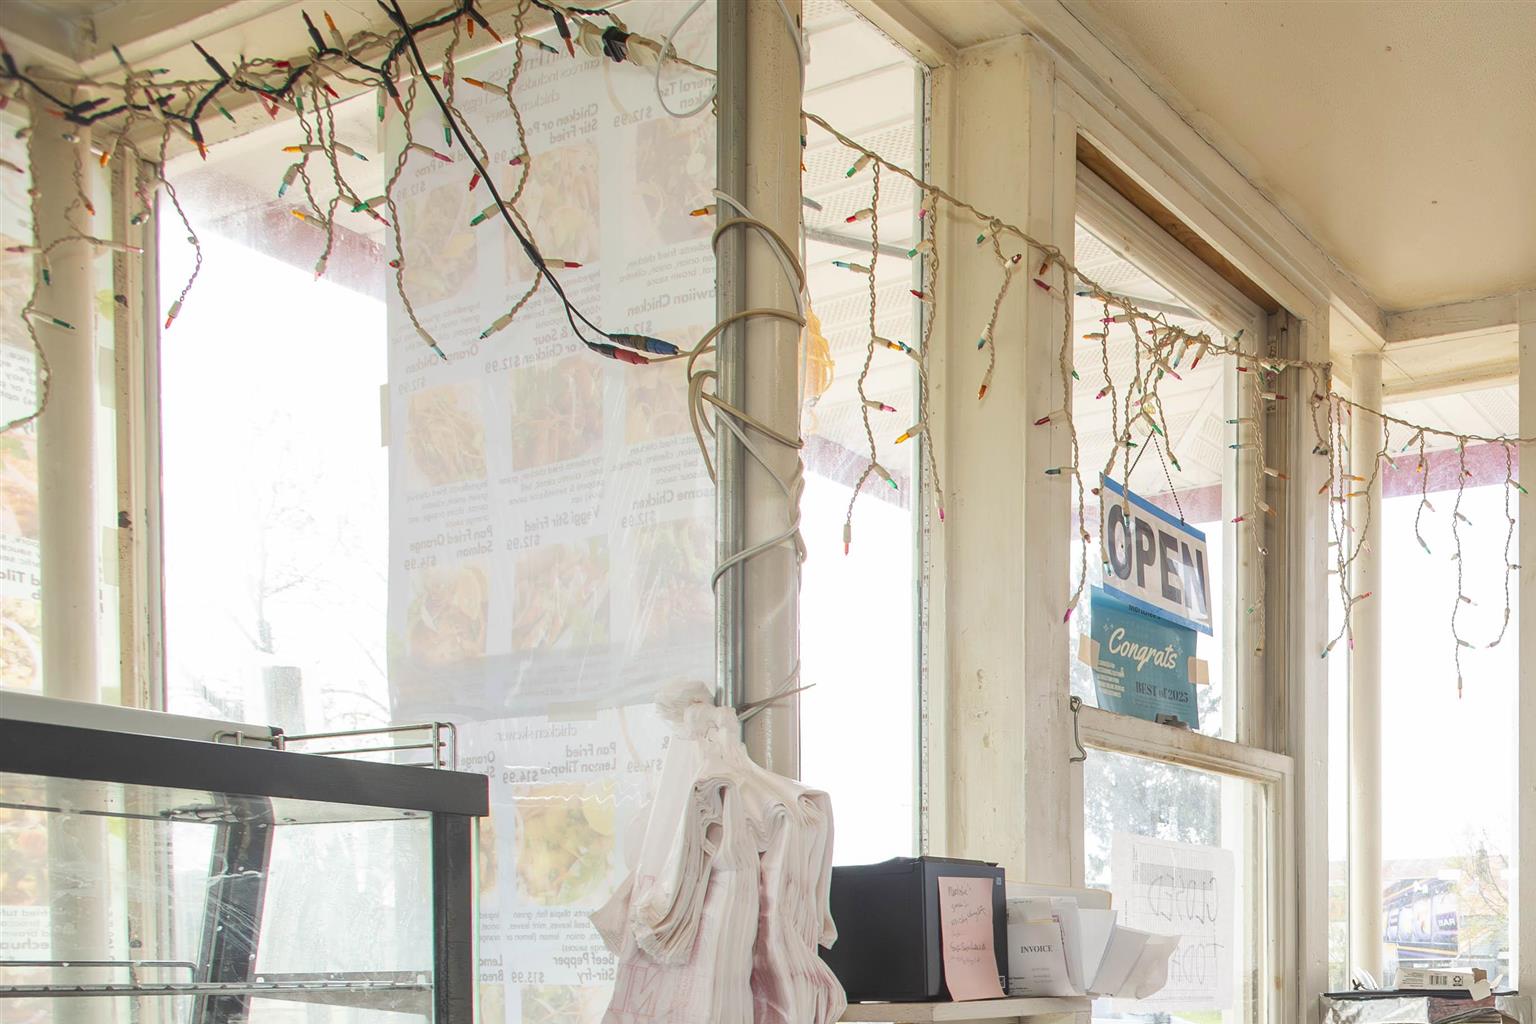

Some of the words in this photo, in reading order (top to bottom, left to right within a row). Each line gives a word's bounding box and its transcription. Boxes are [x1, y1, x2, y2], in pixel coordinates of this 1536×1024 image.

[1108, 504, 1208, 614] OPEN
[1109, 627, 1178, 672] Congrats
[1136, 681, 1156, 697] BEST
[1167, 688, 1189, 703] 2025
[1440, 918, 1455, 926] BAR
[1020, 945, 1053, 954] INVOICE
